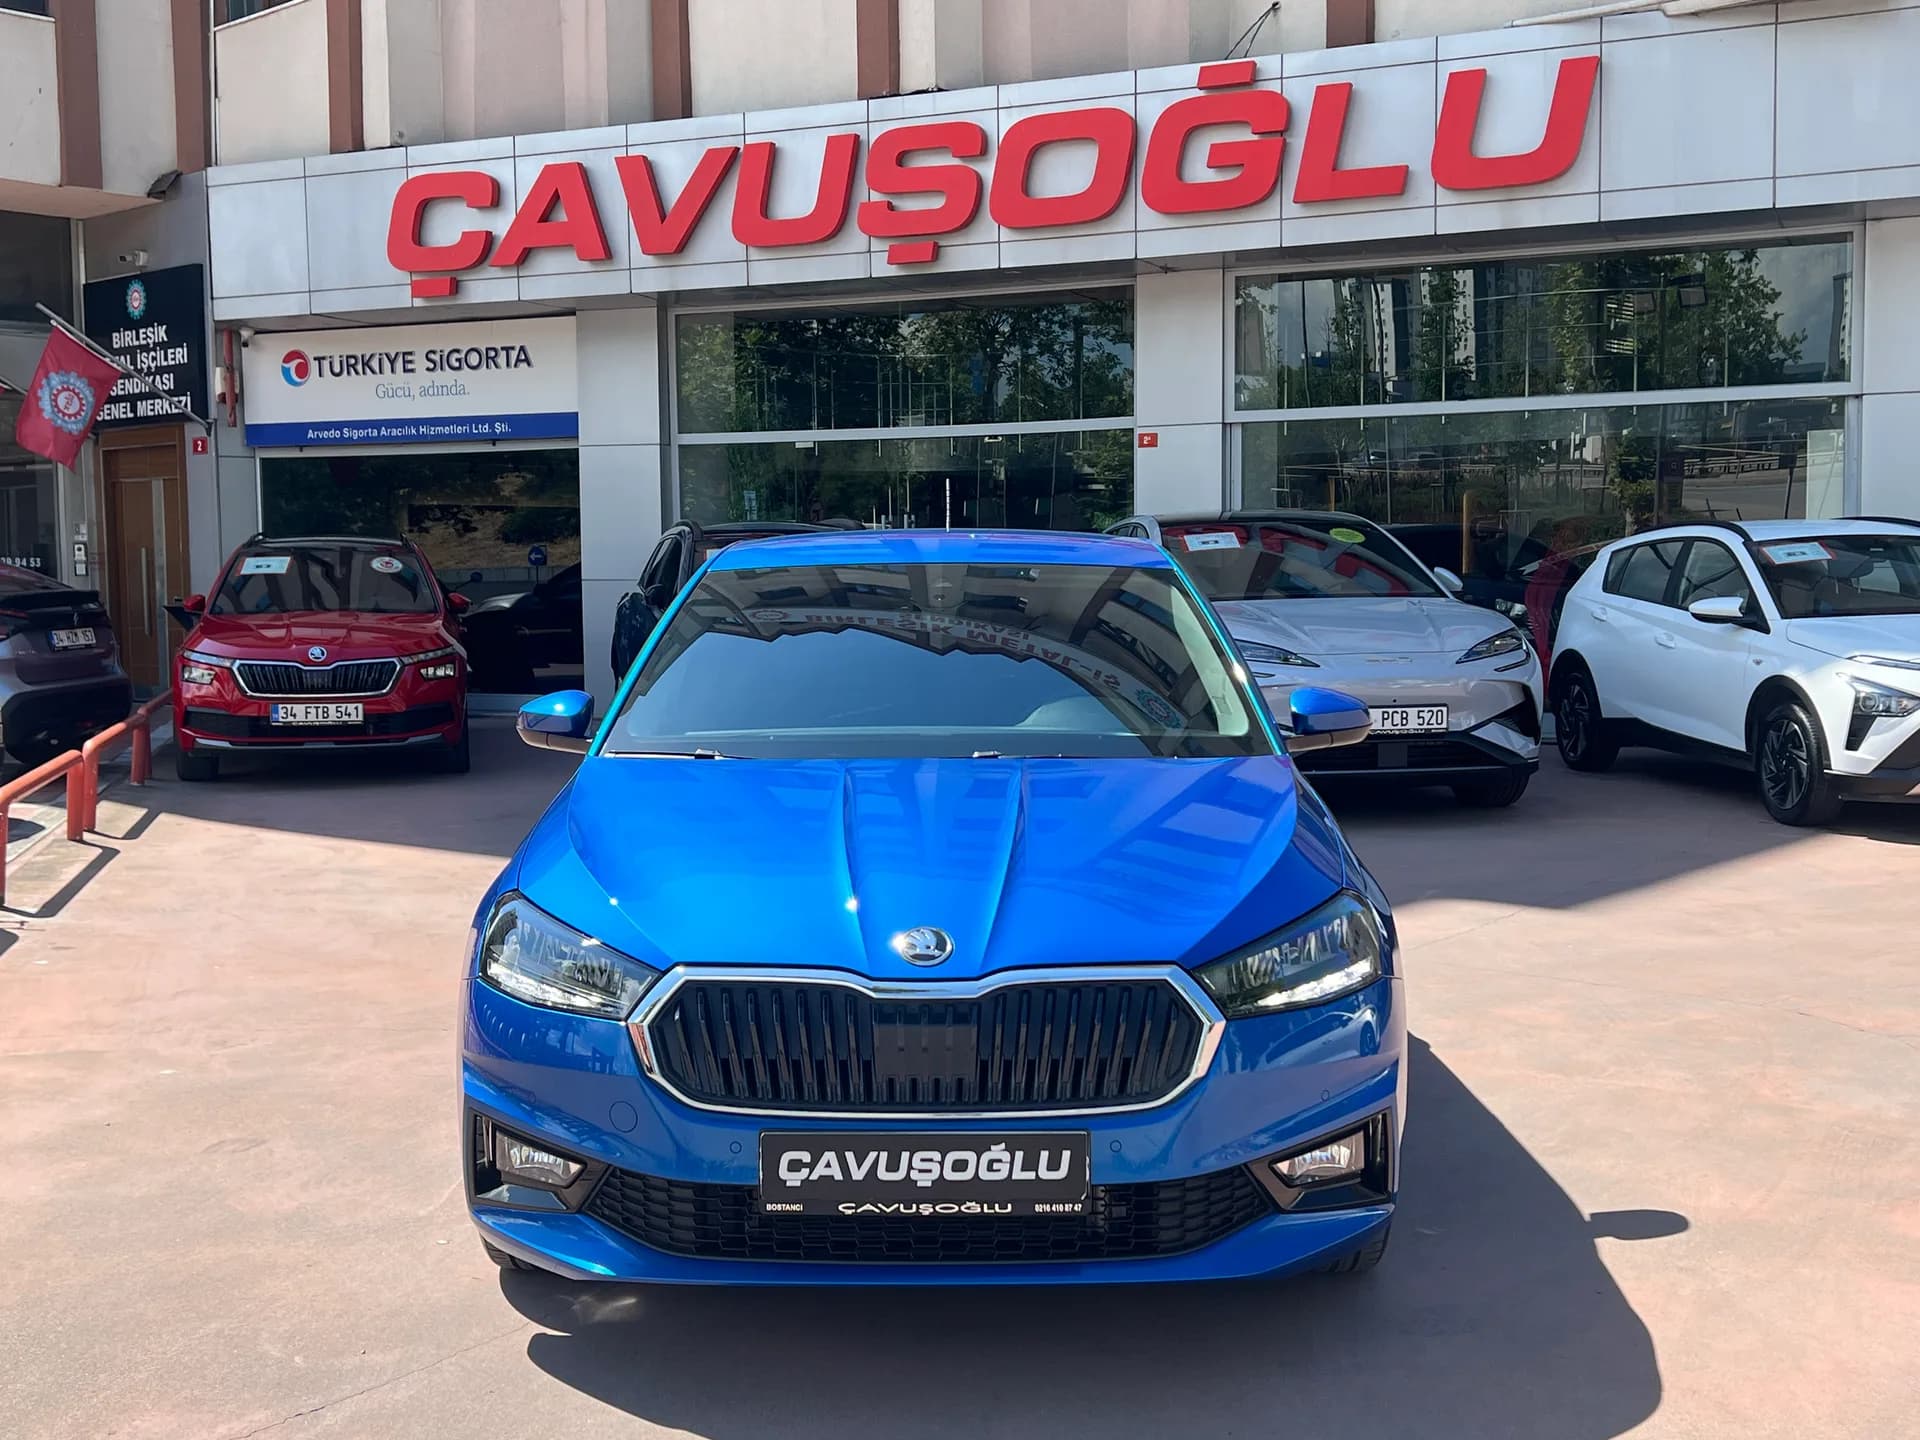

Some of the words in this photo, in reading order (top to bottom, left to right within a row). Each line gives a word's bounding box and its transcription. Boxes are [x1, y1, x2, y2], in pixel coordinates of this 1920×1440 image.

[386, 55, 1601, 299] ÇAVUŞOĞLU
[112, 322, 168, 349] BİRLEŞİK
[137, 343, 188, 373] İŞÇİLERİ
[375, 382, 416, 401] Gücü,
[419, 379, 470, 398] adında.
[343, 427, 378, 441] Sigorta
[380, 426, 417, 437] Aracılık
[419, 424, 470, 436] Hizmetleri
[472, 423, 492, 434] Ltd.
[494, 422, 512, 434] Şti.
[197, 440, 203, 451] 2
[280, 705, 297, 720] 34
[305, 705, 330, 720] FTB
[335, 705, 359, 720] 541
[1381, 710, 1409, 728] PCB
[1417, 708, 1444, 726] 520
[778, 1142, 1071, 1187] ÇAVUŞOĞLU
[766, 1203, 803, 1211] BOSTANCI
[838, 1201, 1012, 1215] ÇAVUŞOĞLU
[1051, 1203, 1064, 1213] 410
[1073, 1203, 1083, 1212] 47
